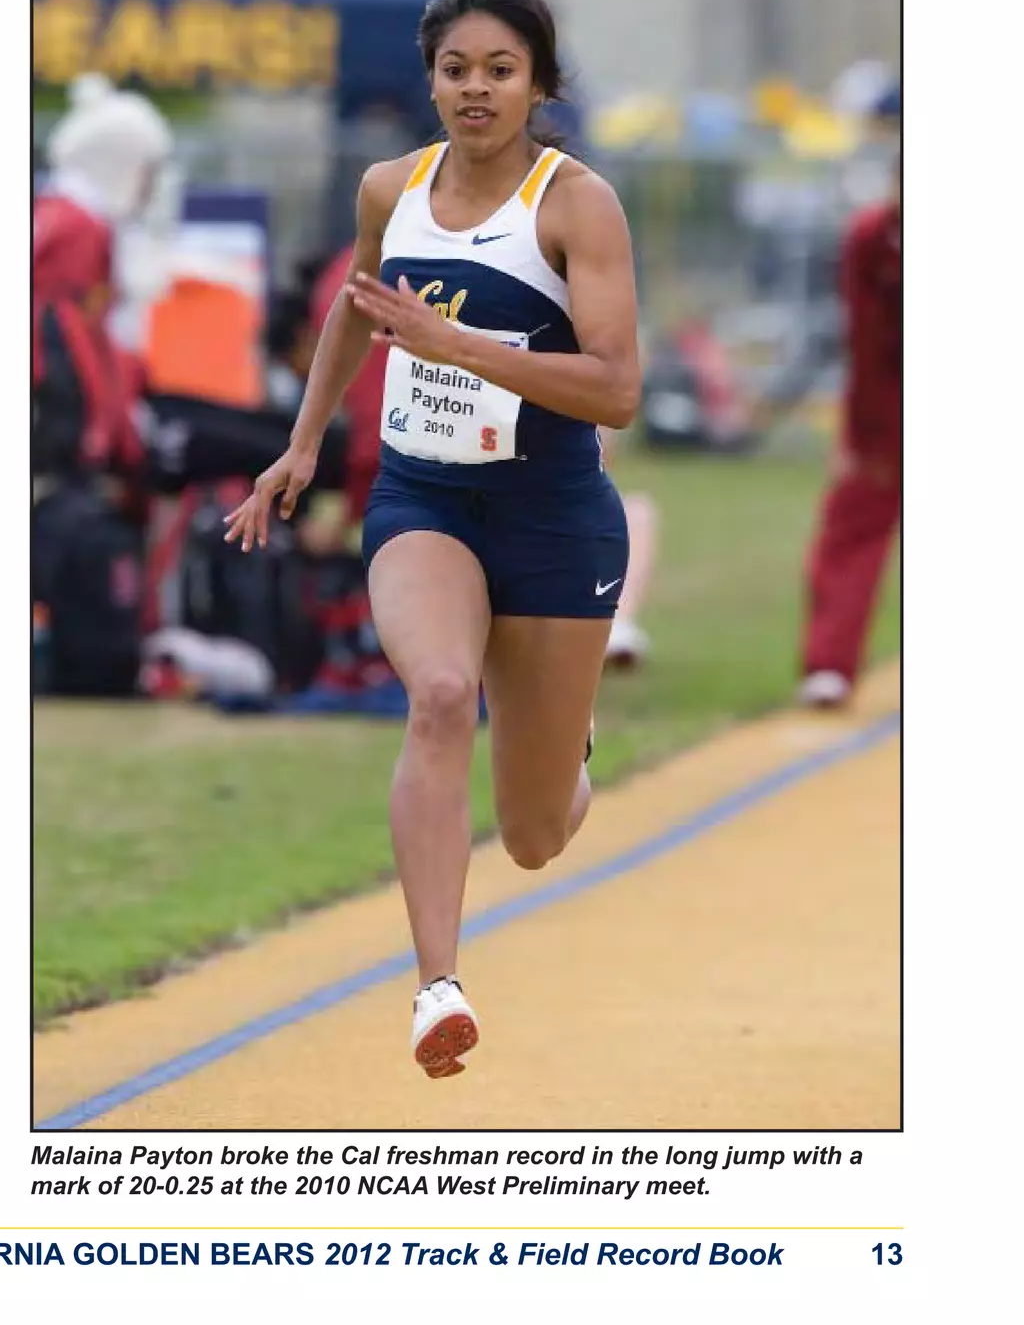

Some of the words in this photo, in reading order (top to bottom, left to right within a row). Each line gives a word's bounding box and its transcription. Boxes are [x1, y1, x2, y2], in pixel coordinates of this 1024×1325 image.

[412, 362, 482, 391] Malaina
[412, 388, 473, 415] Payton
[388, 408, 409, 432] Cal
[424, 420, 454, 437] 2010
[31, 1146, 122, 1165] Malaina
[130, 1146, 212, 1169] Payton
[221, 1146, 288, 1165] broke
[297, 1146, 333, 1164] the
[342, 1146, 380, 1165] Cal
[387, 1146, 498, 1165] freshman
[507, 1146, 585, 1165] record
[592, 1146, 613, 1164] in
[622, 1146, 658, 1164] the
[666, 1146, 718, 1169] long
[722, 1146, 785, 1169] jump
[793, 1146, 841, 1164] with
[850, 1151, 862, 1164] a
[31, 1176, 91, 1195] mark
[99, 1176, 124, 1195] of
[129, 1176, 213, 1195] 20-0.25
[221, 1177, 244, 1195] at
[251, 1176, 287, 1195] the
[295, 1176, 350, 1195] 2010
[358, 1176, 428, 1195] NCAA
[438, 1176, 496, 1195] West
[503, 1176, 640, 1200] Preliminary
[646, 1177, 709, 1195] meet.
[74, 1243, 199, 1265] GOLDEN
[212, 1243, 314, 1265] BEARS
[325, 1243, 391, 1265] 2012
[402, 1243, 480, 1265] Track
[489, 1243, 508, 1265] &
[518, 1243, 589, 1265] Field
[597, 1243, 701, 1265] Record
[709, 1243, 784, 1265] Book
[872, 1243, 902, 1265] 13
